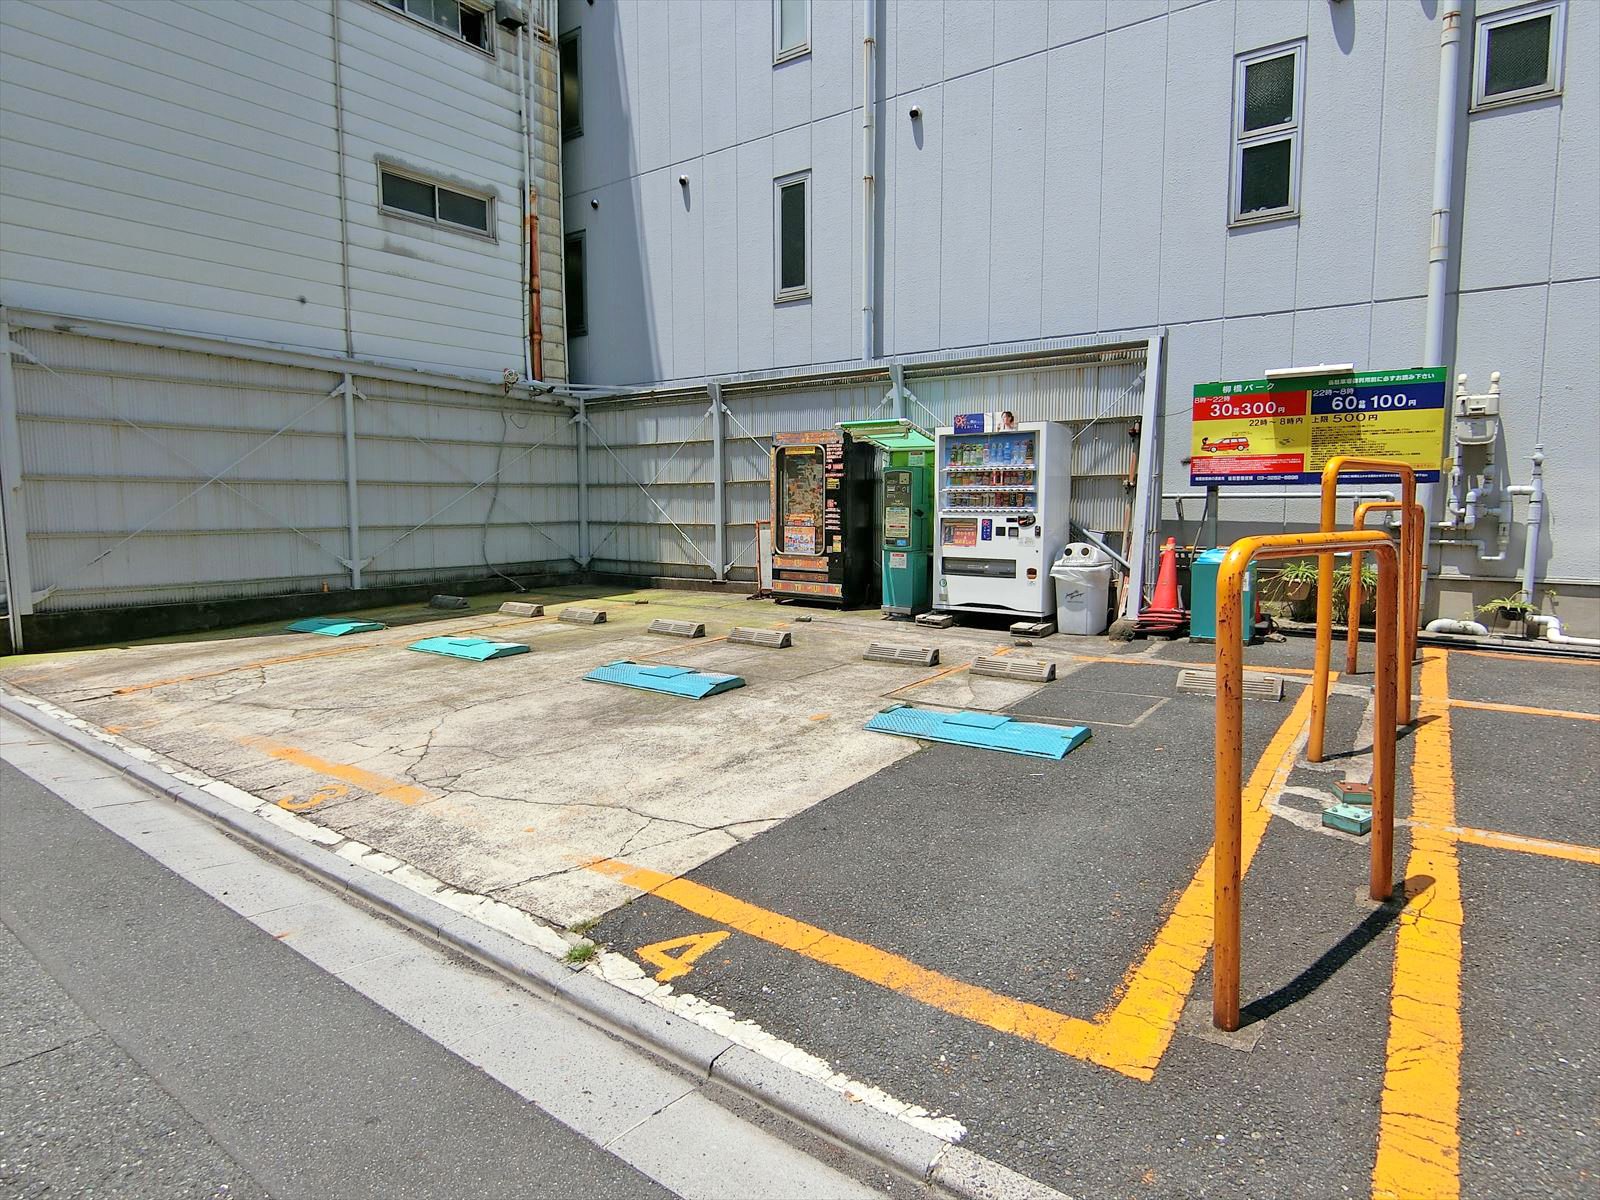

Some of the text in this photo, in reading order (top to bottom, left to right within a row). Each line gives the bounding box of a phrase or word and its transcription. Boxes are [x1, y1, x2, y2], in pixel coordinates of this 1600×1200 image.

[1222, 383, 1275, 393] 柳橋パーク
[634, 930, 732, 982] 4
